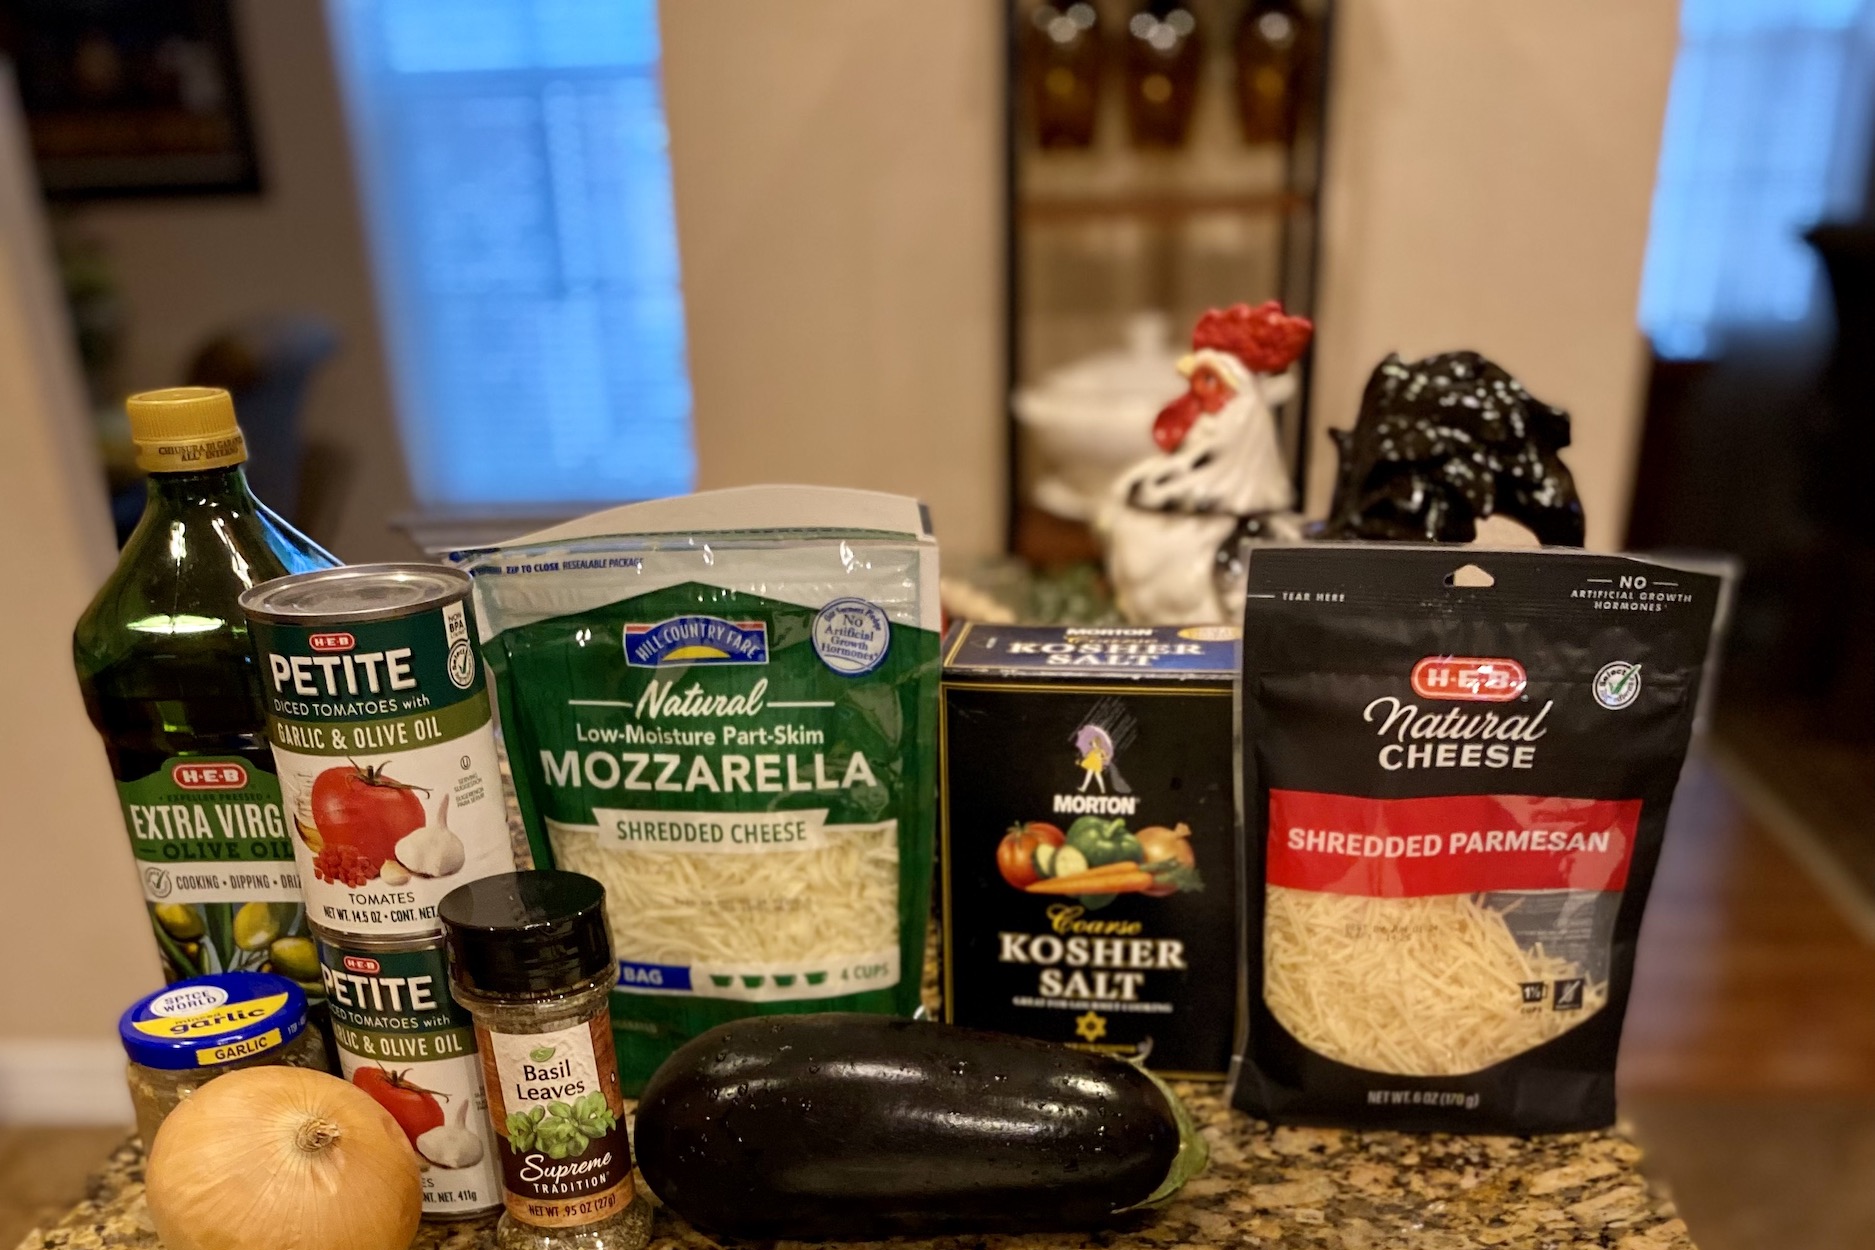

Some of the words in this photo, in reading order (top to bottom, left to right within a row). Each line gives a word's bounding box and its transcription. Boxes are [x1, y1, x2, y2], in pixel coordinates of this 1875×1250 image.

[506, 566, 520, 575] ZIP
[521, 565, 532, 574] TO
[533, 562, 560, 573] CLOSE
[562, 558, 607, 571] RESEALABLE
[608, 556, 644, 568] PACKAGE
[1619, 575, 1648, 590] NO
[1282, 591, 1310, 601] TEAR
[1316, 592, 1345, 602] HERE
[1570, 589, 1634, 600] ARTIFICIAL
[1639, 592, 1693, 603] GROWTH
[1594, 600, 1662, 612] HORMONES
[449, 620, 464, 633] BPA
[843, 614, 863, 628] No
[635, 635, 665, 662] HILL
[663, 622, 726, 644] COUNTRY
[726, 631, 760, 660] FARE
[824, 624, 874, 642] Artificial
[1065, 628, 1153, 637] MORTON
[831, 636, 868, 651] Growth
[1008, 641, 1205, 656] KOSHER
[1046, 653, 1160, 667] SALT
[269, 647, 418, 697] PETITE
[274, 698, 310, 716] DICED
[312, 698, 398, 717] TOMATOES
[402, 693, 431, 710] with
[635, 676, 769, 720] Natural
[1363, 696, 1554, 743] Natural
[277, 722, 325, 749] GARLIC
[331, 728, 348, 750] &
[353, 722, 408, 749] OLIVE
[414, 716, 442, 742] OIL
[575, 723, 716, 746] Low-Moisture
[723, 724, 825, 746] Part-Skim
[1378, 743, 1537, 771] CHEESE
[539, 749, 878, 793] MOZZARELLA
[1052, 795, 1136, 815] MORTON
[129, 804, 214, 840] EXTRA
[214, 803, 288, 839] VIRG
[616, 820, 724, 844] SHREDDED
[730, 821, 808, 844] CHEESE
[162, 842, 241, 860] OLIVE
[251, 841, 295, 859] OIL
[1287, 827, 1443, 859] SHREDDED
[1449, 830, 1611, 855] PARMESAN
[176, 874, 220, 890] COOKING
[229, 874, 270, 890] DIPPING
[280, 874, 302, 889] DRIZ
[348, 892, 416, 906] TOMATES
[323, 905, 336, 920] NET
[352, 910, 369, 923] 14.5
[371, 911, 382, 923] OZ
[390, 908, 417, 923] CONT.
[1046, 903, 1143, 935] Coarse
[998, 931, 1188, 970] KOSHER
[623, 965, 664, 986] BAG
[839, 968, 849, 981] 4
[853, 961, 889, 980] CUPS
[320, 962, 438, 1013] PETITE
[1039, 968, 1145, 1001] SALT
[164, 990, 211, 1005] SPICE
[164, 996, 217, 1013] WORLD
[170, 1008, 266, 1035] garlic
[348, 1010, 418, 1029] TOMATOES
[423, 1014, 450, 1028] with
[215, 1037, 268, 1061] GARLIC
[334, 1022, 359, 1050] RLIC
[363, 1035, 377, 1054] &
[380, 1037, 428, 1057] OLIVE
[434, 1033, 463, 1054] OIL
[523, 1059, 571, 1082] Basil
[516, 1080, 585, 1101] Leaves
[1368, 1090, 1390, 1104] NET
[1423, 1091, 1439, 1105] OZ
[519, 1151, 613, 1184] Supreme
[533, 1173, 607, 1194] TRADITION
[423, 1192, 437, 1203] NT.
[458, 1189, 477, 1202] 411g
[528, 1204, 544, 1217] NET
[546, 1205, 559, 1217] WT
[562, 1203, 577, 1217] .95
[580, 1202, 593, 1215] OZ
[594, 1193, 616, 1212] (27g)
